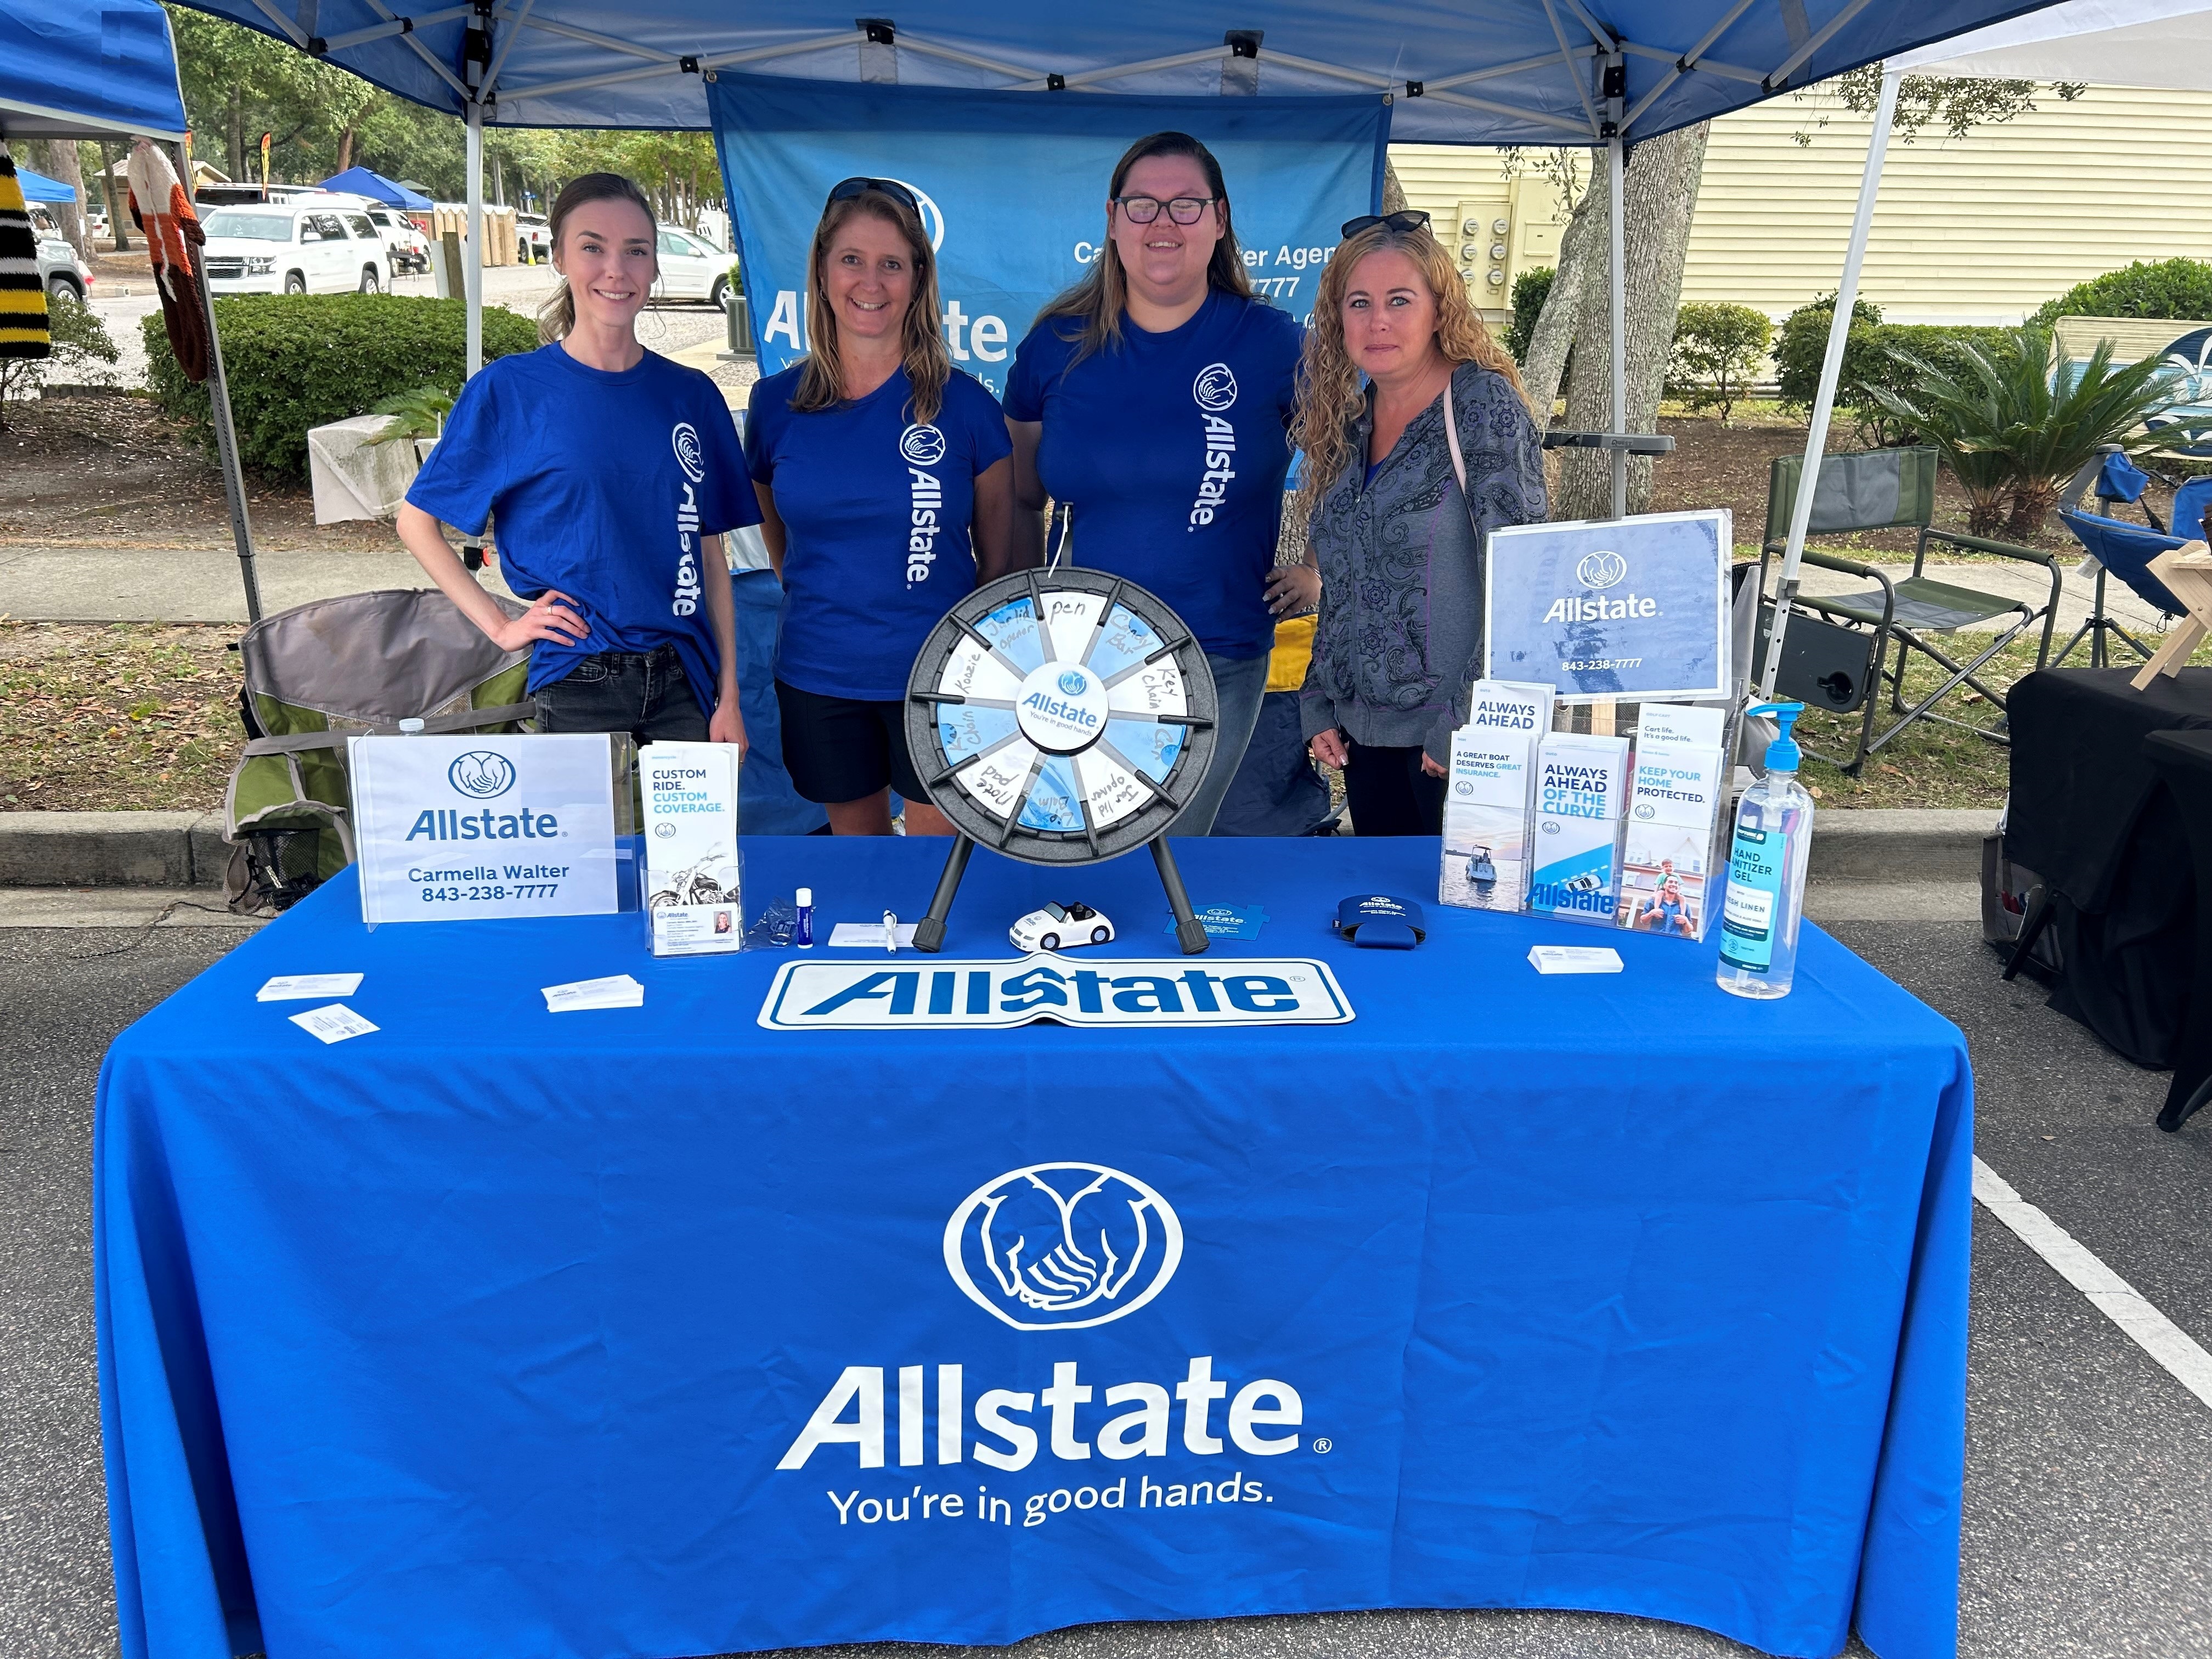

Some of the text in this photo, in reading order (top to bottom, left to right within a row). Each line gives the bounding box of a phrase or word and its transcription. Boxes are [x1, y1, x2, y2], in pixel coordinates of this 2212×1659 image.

[1189, 413, 1236, 526] Allstate
[906, 467, 943, 582] Allstate
[1050, 600, 1086, 625] pen
[1542, 593, 1656, 624] Allstate
[985, 605, 1030, 637] Jar lid
[1000, 624, 1035, 650] opener
[1109, 613, 1154, 651] Candy
[1105, 632, 1134, 655] Bar
[1561, 658, 1643, 672] 843-238-7777
[1022, 692, 1097, 728] Allstate
[1477, 701, 1536, 716] ALWAYS
[1030, 710, 1049, 723] You're
[1056, 721, 1073, 730] good
[1073, 725, 1092, 737] hands
[1476, 713, 1534, 730] AHEAD
[1456, 759, 1494, 769] DESERVES
[1463, 752, 1487, 760] GREAT
[652, 769, 707, 779] CUSTOM
[981, 765, 1020, 792] pad
[1455, 768, 1501, 778] INSURANCE.
[1544, 764, 1608, 780] ALWAYS
[1639, 765, 1701, 781] KEEP YOUR
[653, 781, 686, 791] RIDE.
[1544, 776, 1607, 793] AHEAD
[1638, 776, 1673, 788] HOME
[653, 792, 708, 802] CUSTOM
[1543, 788, 1607, 806] OF THE
[1637, 787, 1706, 804] PROTECTED.
[654, 803, 725, 814] COVERAGE.
[1543, 801, 1606, 821] CURVE
[405, 808, 558, 841] Allstate
[1734, 847, 1761, 862] HAND
[408, 865, 570, 882] Carmella Walter
[1734, 869, 1752, 883] GEL
[422, 884, 558, 902] 843-238-7777
[1524, 883, 1615, 915] Allstate
[1740, 902, 1765, 913] LINEN
[799, 967, 1300, 1016] Allstate
[775, 1355, 1304, 1472] Allstate
[826, 1471, 1274, 1527] You're in good hands.
